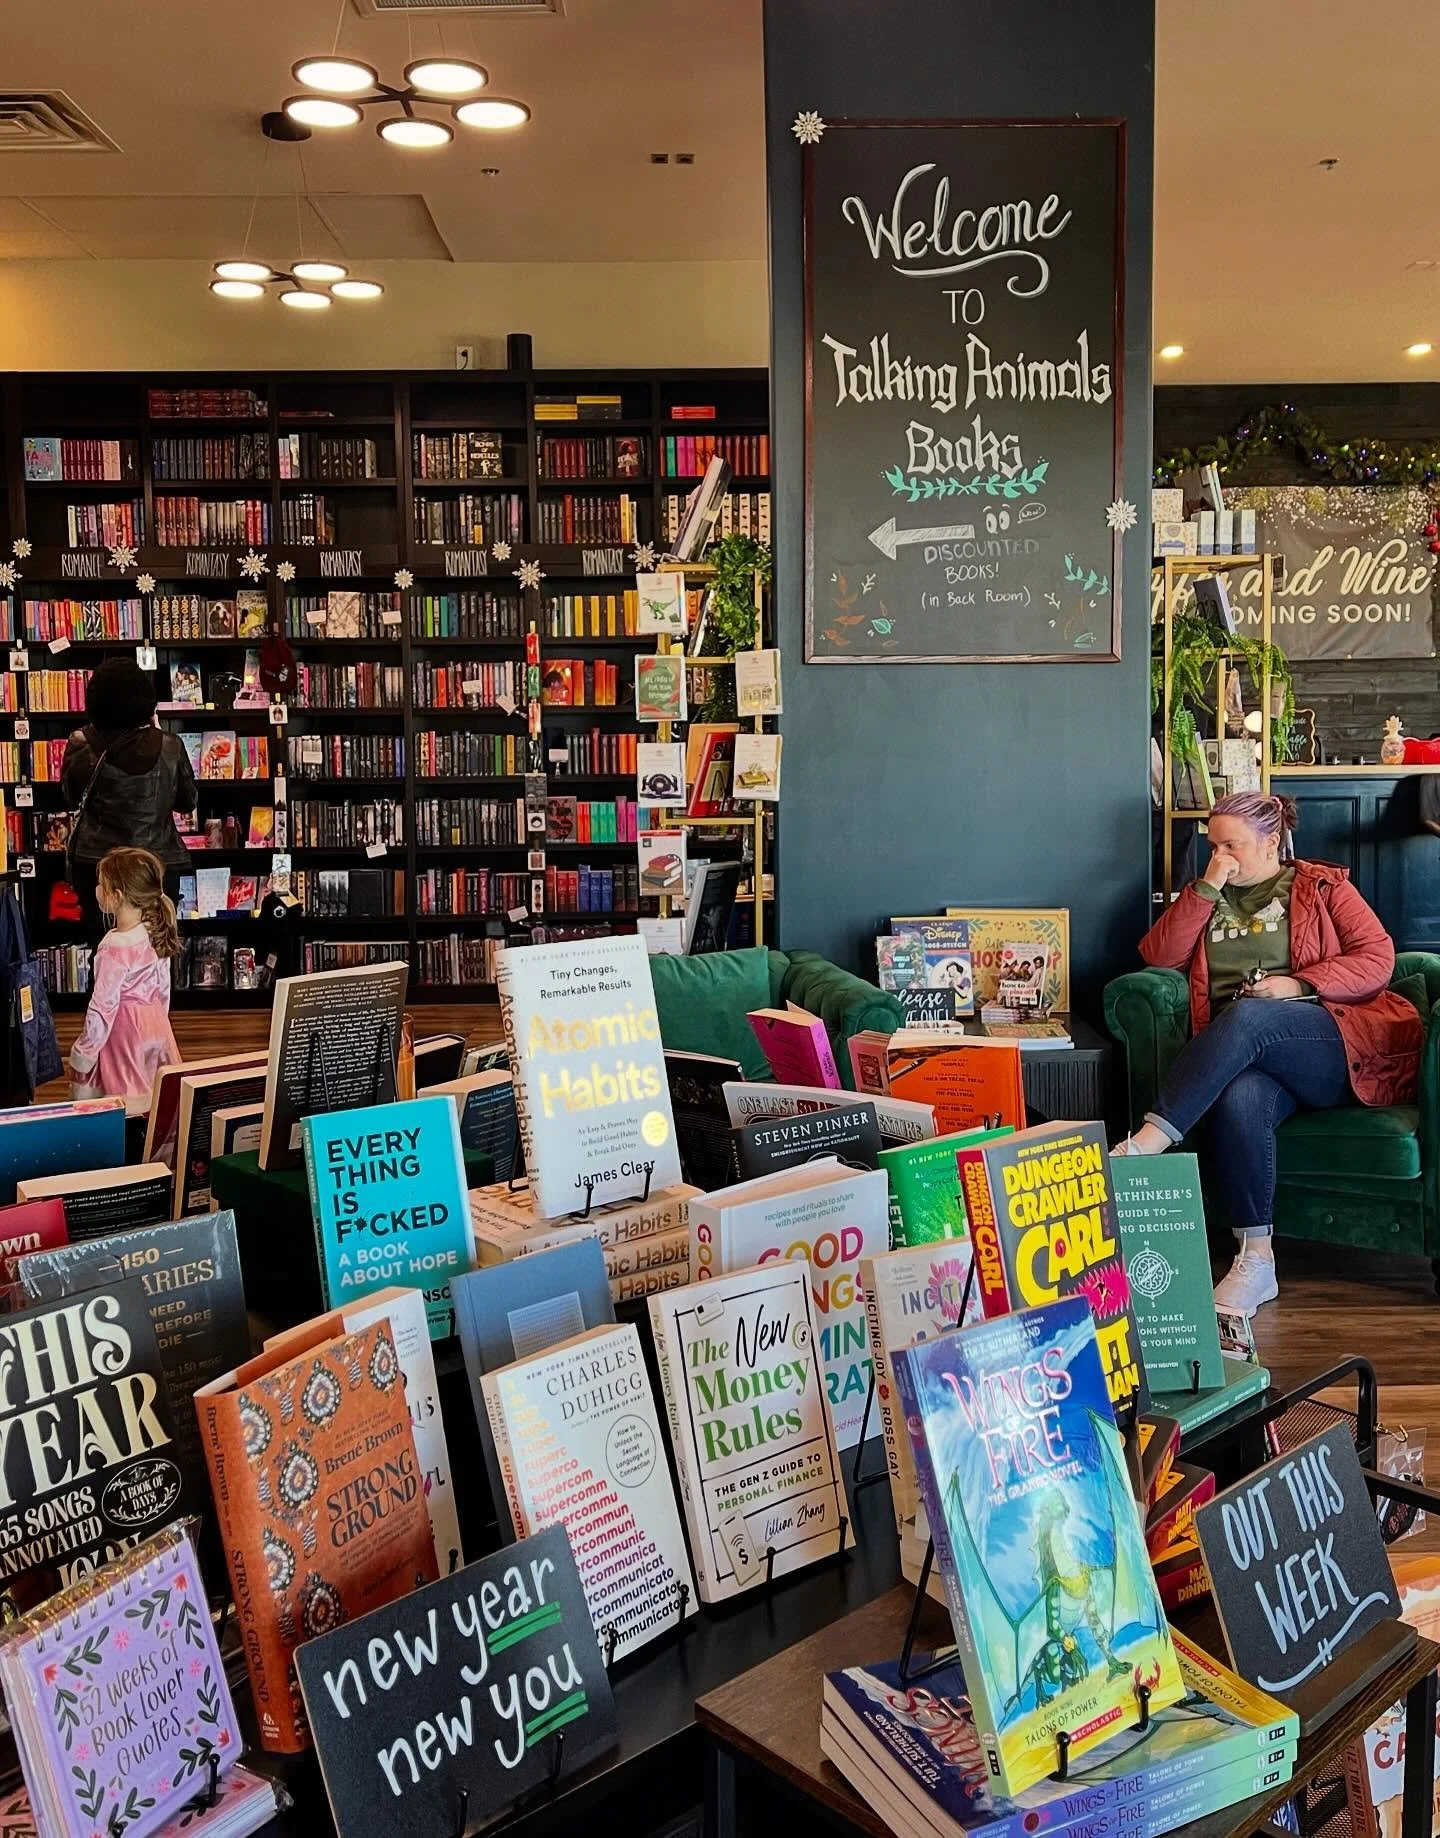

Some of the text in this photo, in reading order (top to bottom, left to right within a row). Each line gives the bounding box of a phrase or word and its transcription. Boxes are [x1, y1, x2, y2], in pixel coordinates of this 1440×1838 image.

[842, 163, 1072, 260] Welcome
[942, 289, 985, 324] TO
[822, 329, 1112, 414] Talking Animals
[905, 414, 1023, 478] Books
[924, 539, 1038, 564] DISCOUNTED
[944, 562, 999, 583] BOOKS!
[1340, 538, 1432, 596] Wine
[948, 590, 975, 606] Back
[985, 586, 1031, 607] Room)
[1230, 603, 1411, 624] OMING SOON!
[540, 980, 632, 999] Remarkable Results
[550, 965, 618, 981] Tiny Changes,
[500, 993, 520, 1077] Atomic
[526, 1002, 660, 1058] Atomic
[539, 1060, 661, 1119] Habits
[738, 1096, 796, 1115] ONE LAST
[513, 1083, 533, 1159] Habits
[754, 1112, 869, 1146] STEVEN PINKER
[327, 1128, 421, 1164] EVERY
[1002, 1142, 1103, 1195] DUNGEON
[329, 1155, 421, 1189] THING
[574, 1160, 655, 1188] James Clear
[963, 1161, 984, 1226] CRAWLER
[973, 1161, 993, 1227] DUNGEON
[1128, 1177, 1149, 1186] THE
[333, 1191, 359, 1216] IS
[764, 1192, 856, 1222] recipes and rituals to share
[775, 1204, 846, 1229] with people you love
[1008, 1173, 1108, 1229] CRAWLER
[1115, 1188, 1193, 1202] RTHINKER'S
[1118, 1208, 1167, 1218] GUIDE TO
[615, 1211, 672, 1240] Habits
[1138, 1222, 1196, 1233] DECISIONS
[121, 1248, 160, 1271] 150
[338, 1241, 408, 1268] A BOOK
[340, 1250, 458, 1288] ABOUT HOPE
[975, 1226, 1004, 1296] CARL
[1015, 1206, 1116, 1308] CARL
[619, 1270, 680, 1298] Habits
[154, 1309, 213, 1333] BEFORE
[687, 1304, 790, 1368] The New
[865, 1289, 887, 1380] INCITING JOY
[1147, 1313, 1184, 1323] TO MAKE
[1160, 1324, 1197, 1335] WITHOUT
[158, 1333, 183, 1349] DIE
[1150, 1337, 1197, 1347] YOUR MIND
[546, 1346, 638, 1397] CHARLES
[692, 1356, 810, 1416] Money
[941, 1346, 1073, 1432] WINGS
[493, 1393, 509, 1445] CHARLES
[560, 1372, 642, 1421] DUHIGG
[660, 1354, 679, 1441] Money Rules
[486, 1397, 500, 1443] DUHIGG
[614, 1435, 634, 1449] Unlock
[617, 1426, 629, 1436] How
[699, 1405, 803, 1465] Rules
[206, 1406, 230, 1502] Brené Brown
[324, 1422, 403, 1475] Brené Brown
[616, 1452, 644, 1470] Language
[622, 1444, 640, 1456] Secret
[882, 1406, 900, 1480] ROSS GAY
[979, 1404, 1072, 1488] FIRE
[120, 1475, 164, 1503] A BOOK OF
[326, 1448, 413, 1522] STRONG
[528, 1458, 579, 1488] superco
[532, 1468, 594, 1505] supercom
[620, 1459, 651, 1478] Connection
[714, 1453, 821, 1498] THE GEN Z GUIDE TO
[716, 1466, 824, 1512] PERSONAL FINANCE
[1050, 1460, 1083, 1483] NOVEL
[24, 1486, 97, 1539] SONGS
[132, 1490, 157, 1512] DAYS
[331, 1474, 418, 1548] GROUND
[534, 1479, 608, 1522] supercomm
[1221, 1444, 1346, 1573] OUT THIS
[764, 1504, 825, 1543] Lillian Zhang
[1254, 1532, 1360, 1656] WEEK
[232, 1548, 270, 1702] STRONG GROUND
[322, 1556, 555, 1720] new year
[80, 1688, 104, 1726] 52
[162, 1628, 180, 1666] of
[1212, 1686, 1248, 1709] TALONS
[90, 1666, 185, 1757] Book Lover
[376, 1642, 584, 1798] new you
[1024, 1697, 1099, 1746] TALONS OF POWER
[1077, 1708, 1122, 1738] SCHOLASTIC
[116, 1706, 182, 1777] Quotes
[1063, 1788, 1106, 1817] WINGS
[1115, 1776, 1144, 1801] FIRE
[1149, 1766, 1174, 1780] TALONS
[1183, 1756, 1205, 1768] POWER
[1117, 1802, 1146, 1825] FIRE
[1150, 1790, 1175, 1804] TALONS
[1184, 1780, 1206, 1794] POWER
[1350, 1767, 1367, 1834] TOMFORDE
[1148, 1814, 1174, 1828] TALONS
